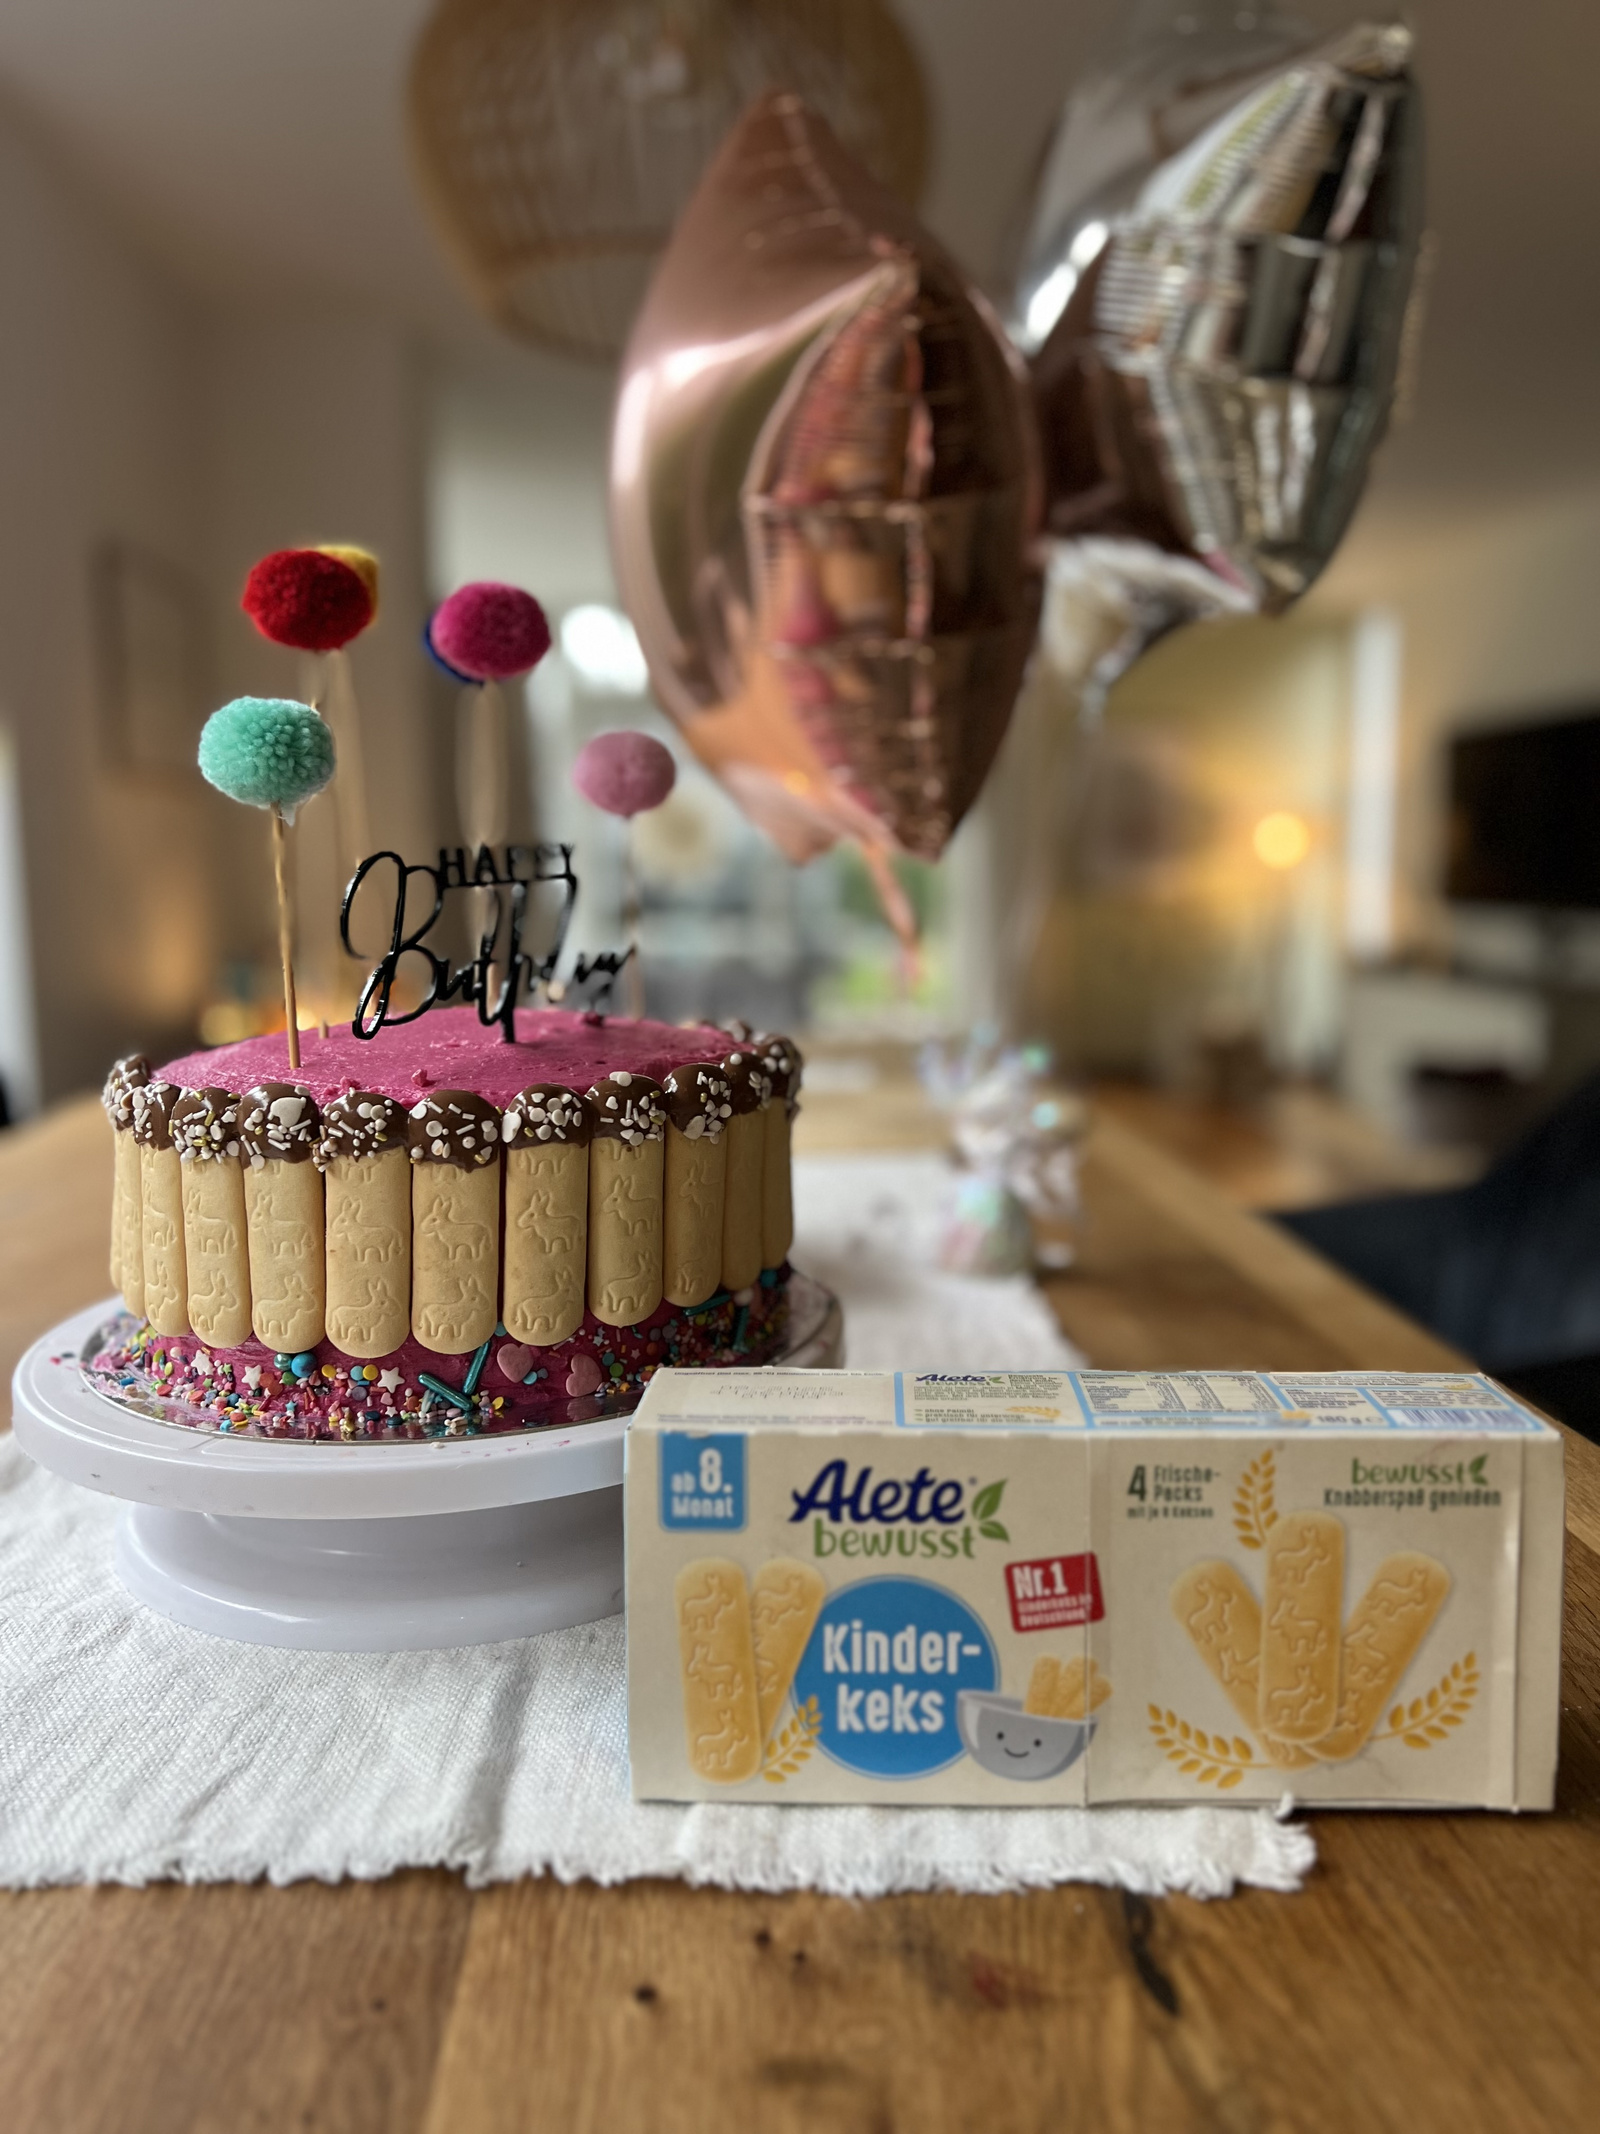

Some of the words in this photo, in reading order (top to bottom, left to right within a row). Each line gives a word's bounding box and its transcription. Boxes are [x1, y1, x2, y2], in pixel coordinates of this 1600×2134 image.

[915, 1374, 987, 1382] Alete
[671, 1471, 697, 1493] ab
[699, 1447, 734, 1494] 8.
[788, 1458, 966, 1524] Alete
[1127, 1464, 1147, 1502] 4
[1351, 1456, 1465, 1486] bewusst
[672, 1495, 734, 1518] Monat
[813, 1516, 976, 1559] bewusst
[823, 1619, 982, 1675] Kinder-
[837, 1682, 945, 1734] keks
